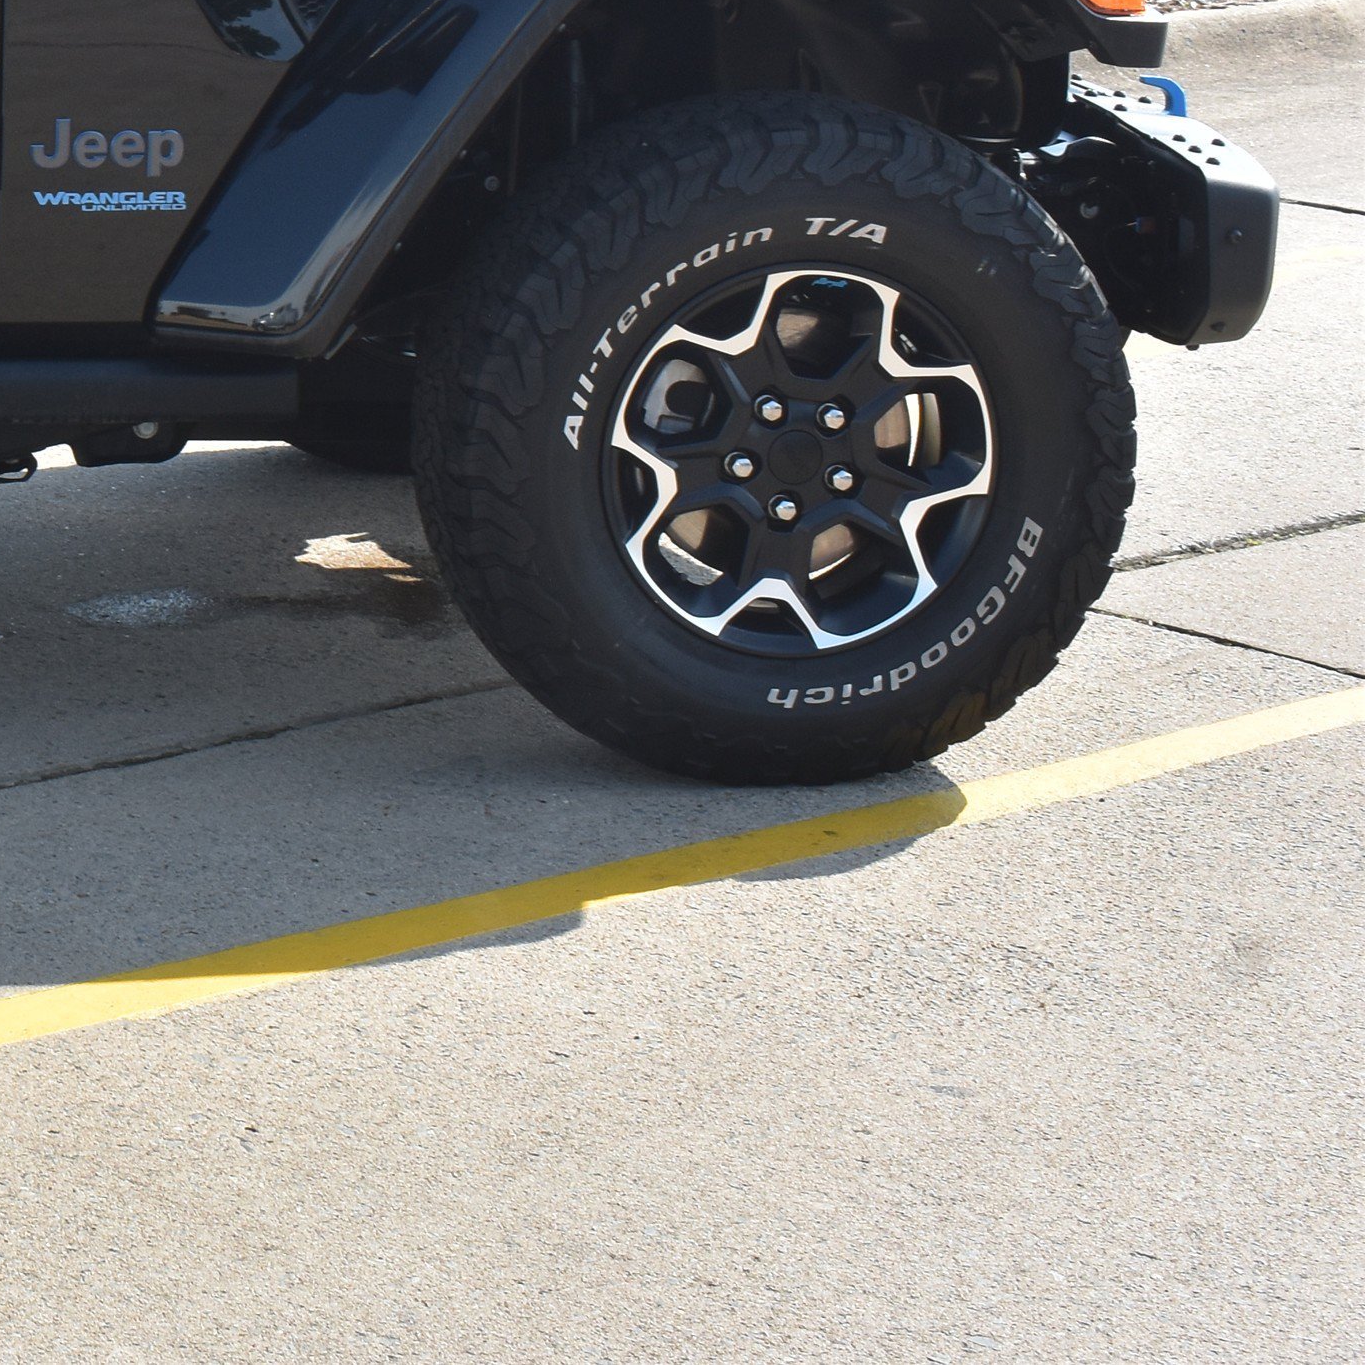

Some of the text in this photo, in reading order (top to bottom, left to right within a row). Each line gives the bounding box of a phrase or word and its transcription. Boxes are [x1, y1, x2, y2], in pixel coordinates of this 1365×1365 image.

[29, 118, 185, 177] Jeep
[33, 191, 186, 206] WRANGLER
[81, 203, 187, 213] UNLIMITED
[563, 217, 889, 451] All-Terrain T/A
[767, 515, 1044, 710] BFGoodrich
